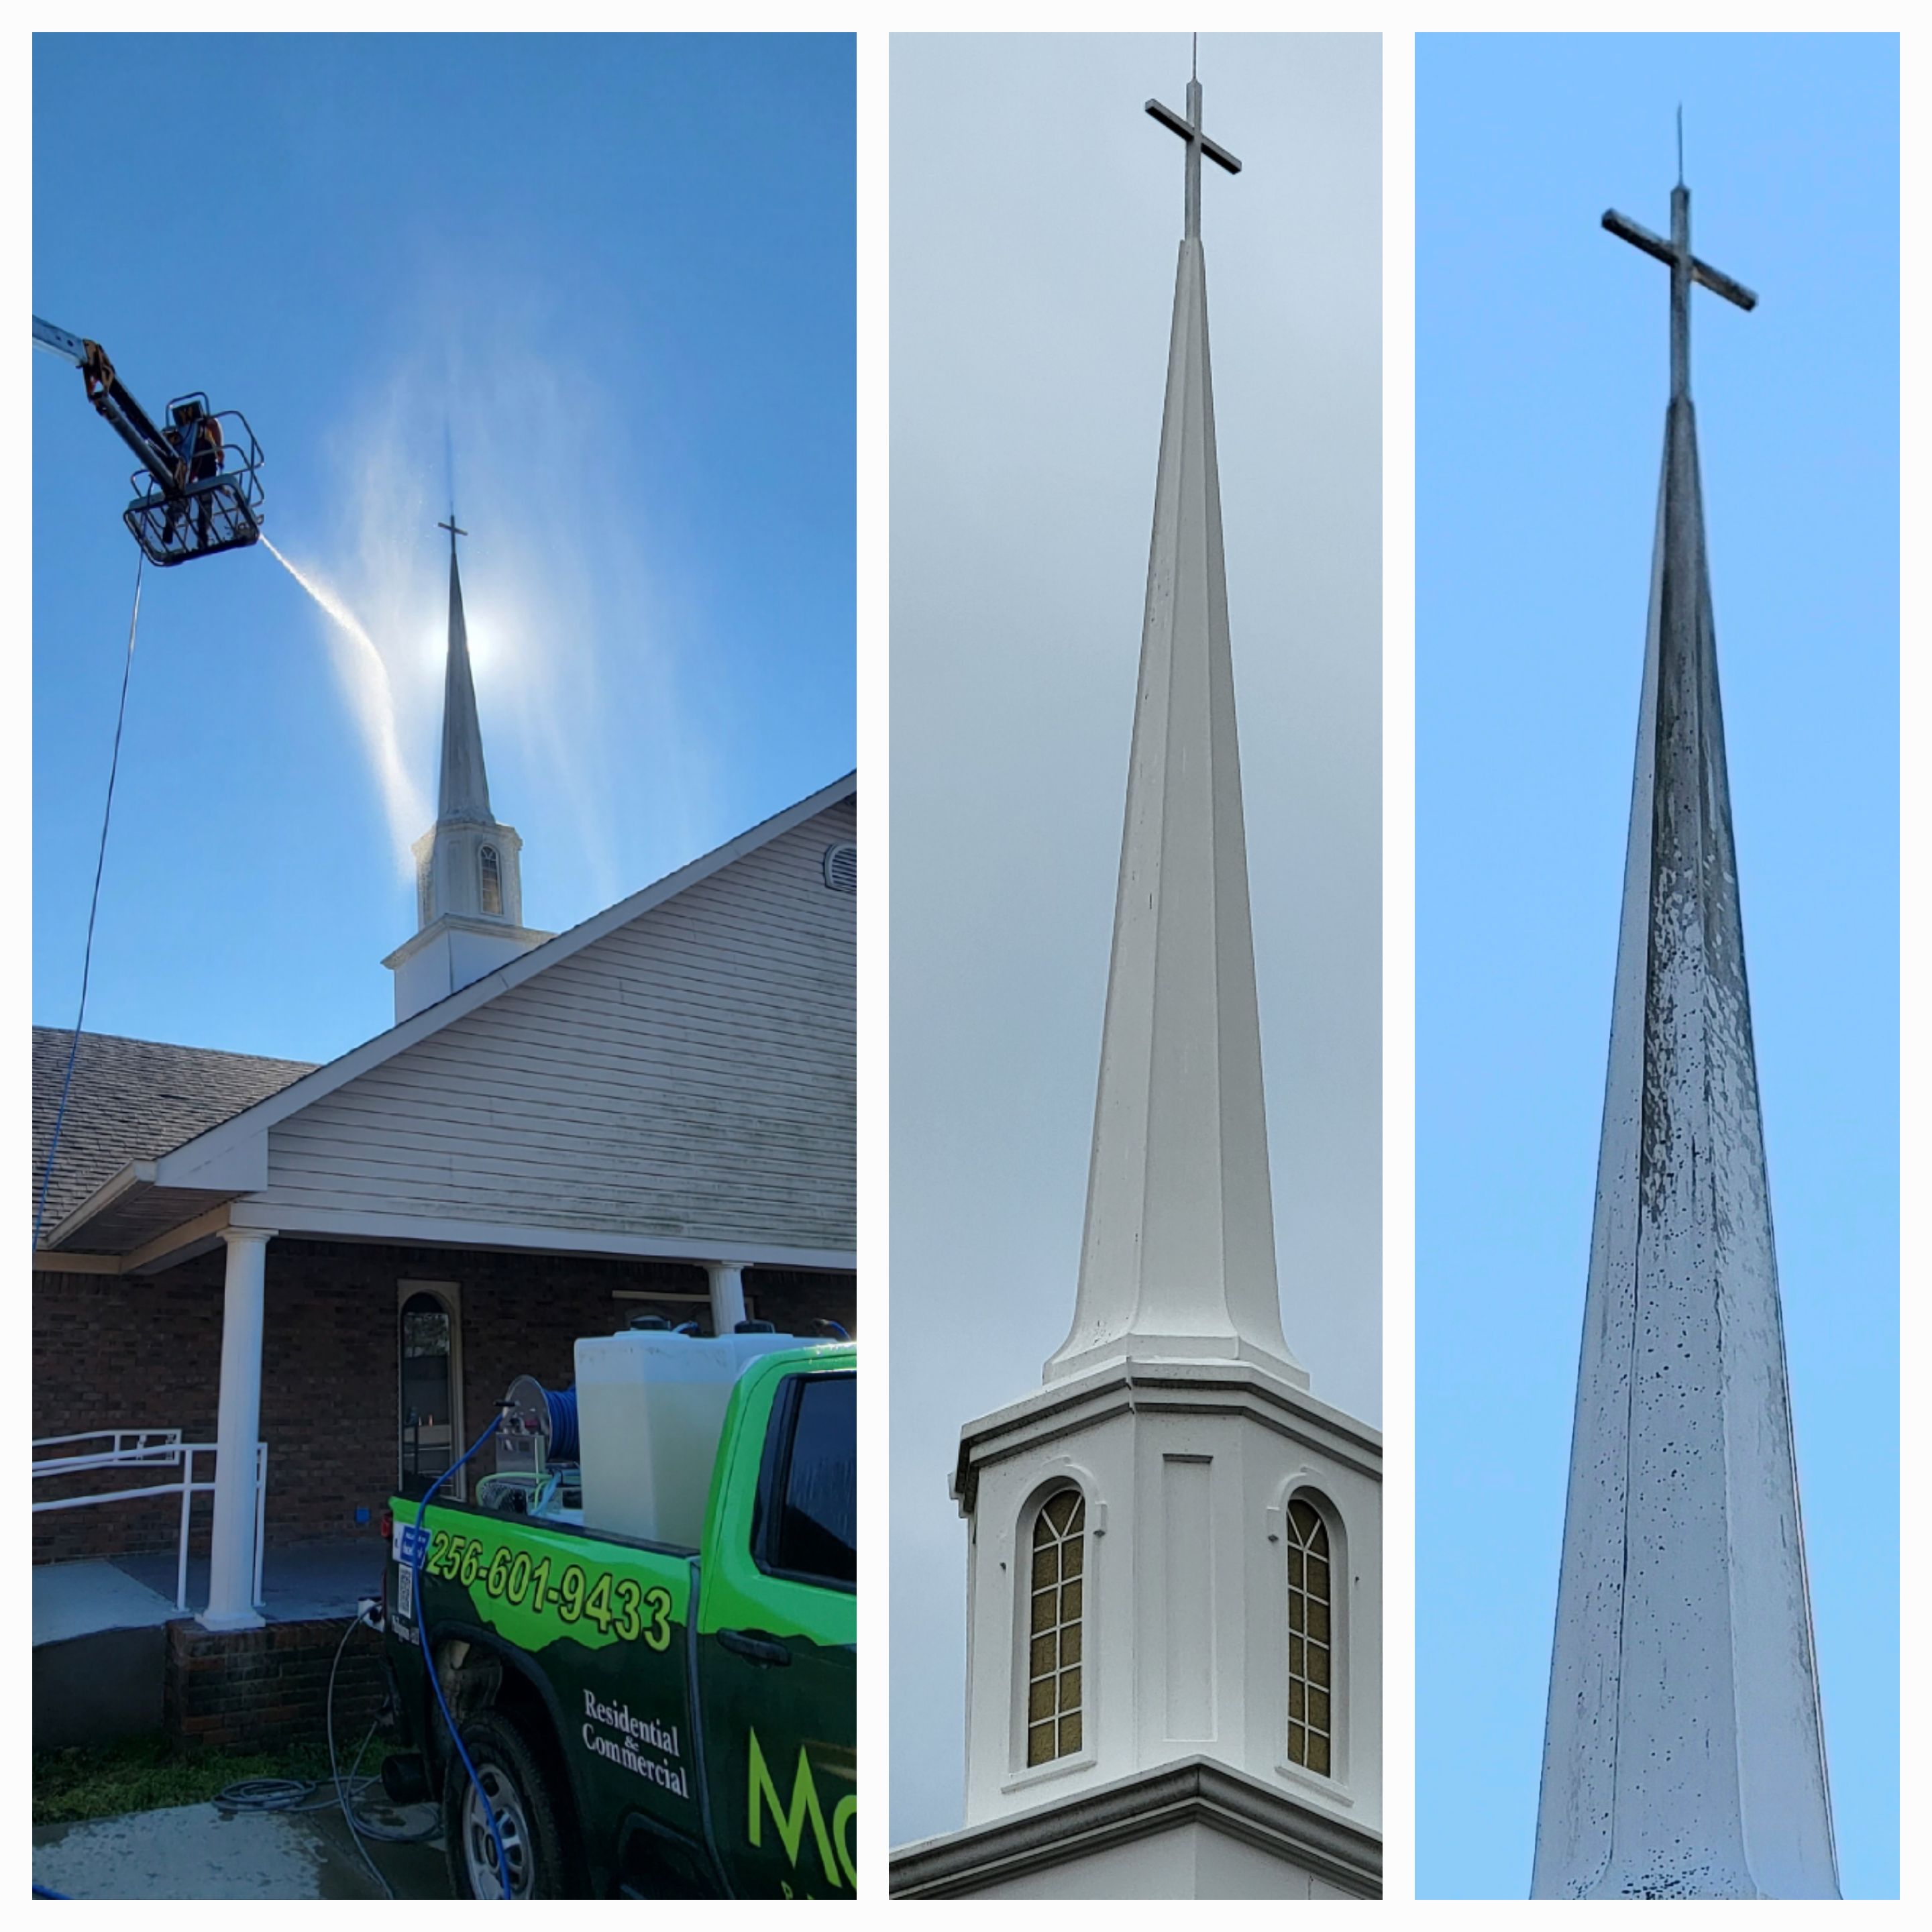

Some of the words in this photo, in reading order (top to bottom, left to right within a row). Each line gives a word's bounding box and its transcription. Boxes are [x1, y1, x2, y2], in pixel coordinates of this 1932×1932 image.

[425, 1531, 672, 1652] 256-601-9433
[583, 1688, 681, 1758] Residential
[625, 1735, 641, 1753] &
[582, 1722, 690, 1799] Commercial
